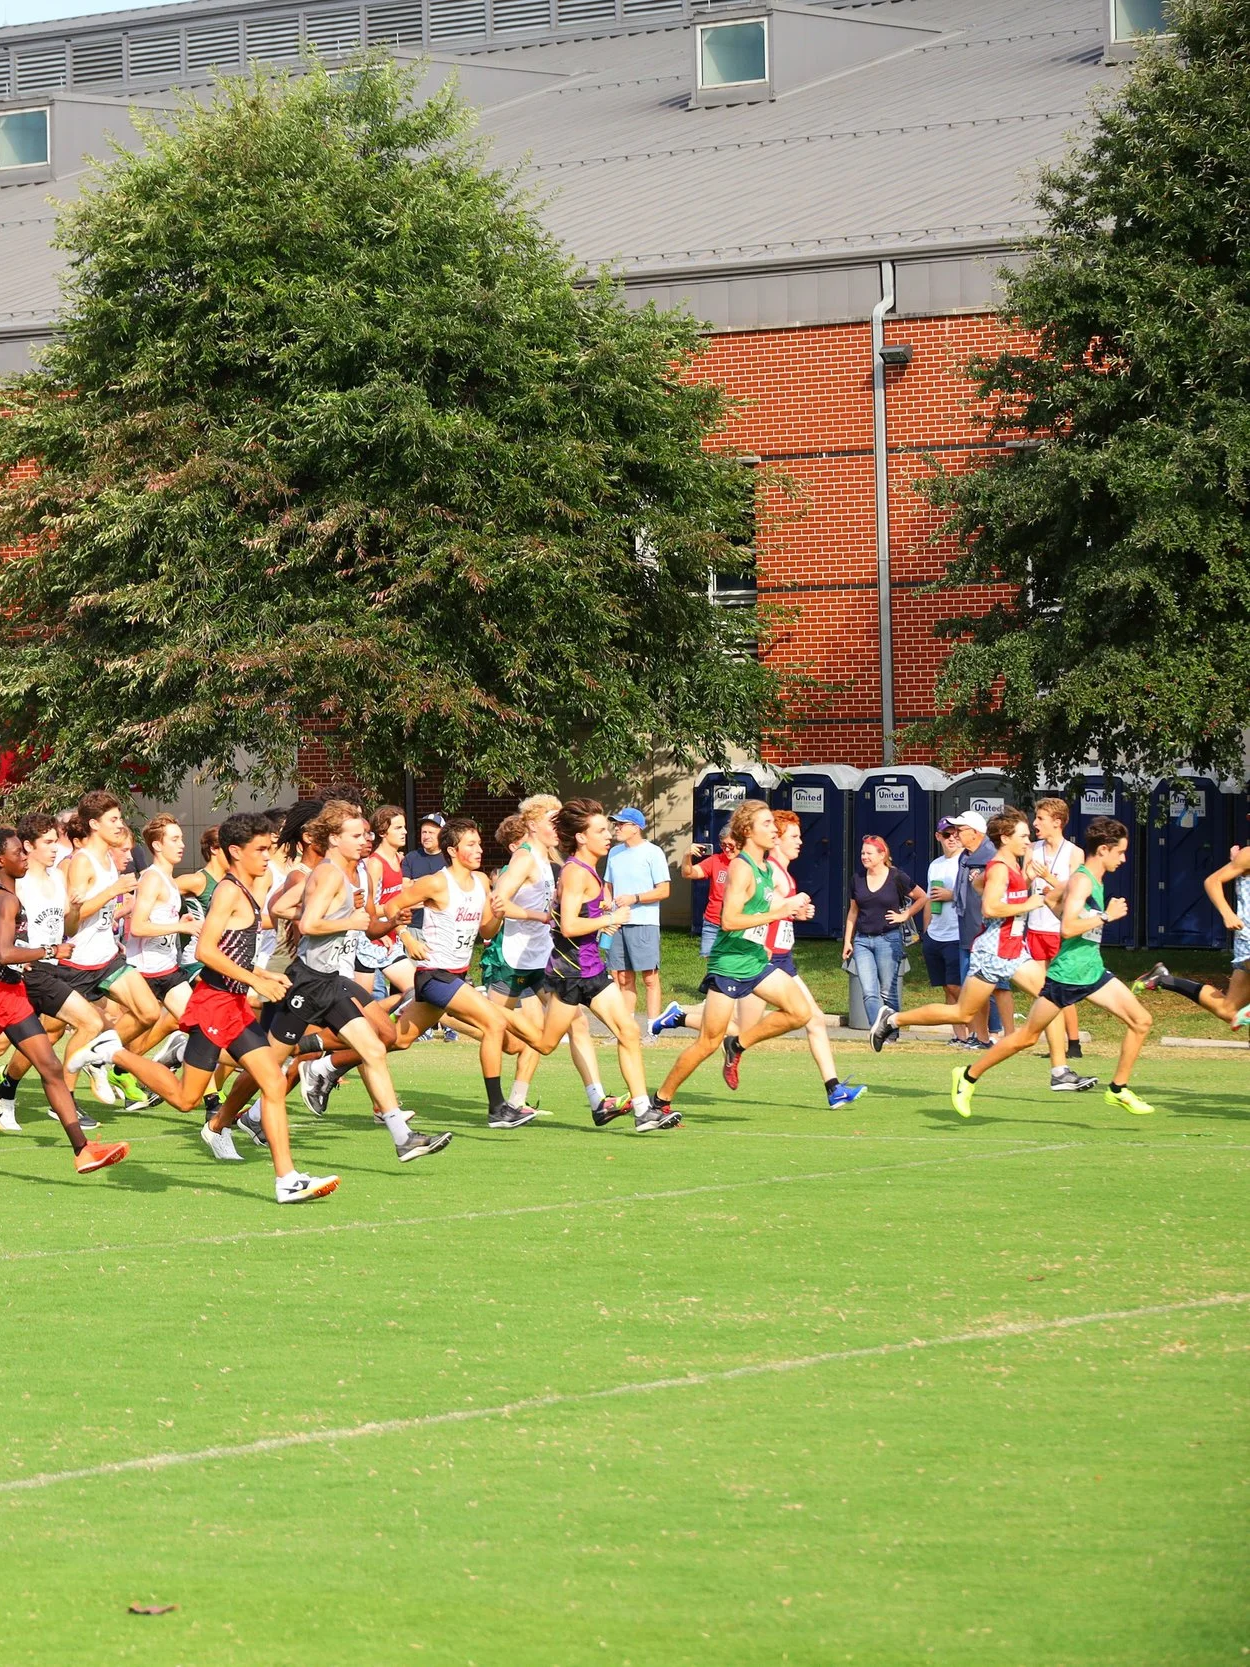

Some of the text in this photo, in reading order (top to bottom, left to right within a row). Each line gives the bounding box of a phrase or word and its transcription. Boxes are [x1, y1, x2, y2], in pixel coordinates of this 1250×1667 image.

[717, 789, 743, 800] United
[795, 792, 821, 801] United
[879, 791, 904, 799] United
[455, 906, 481, 923] Blair
